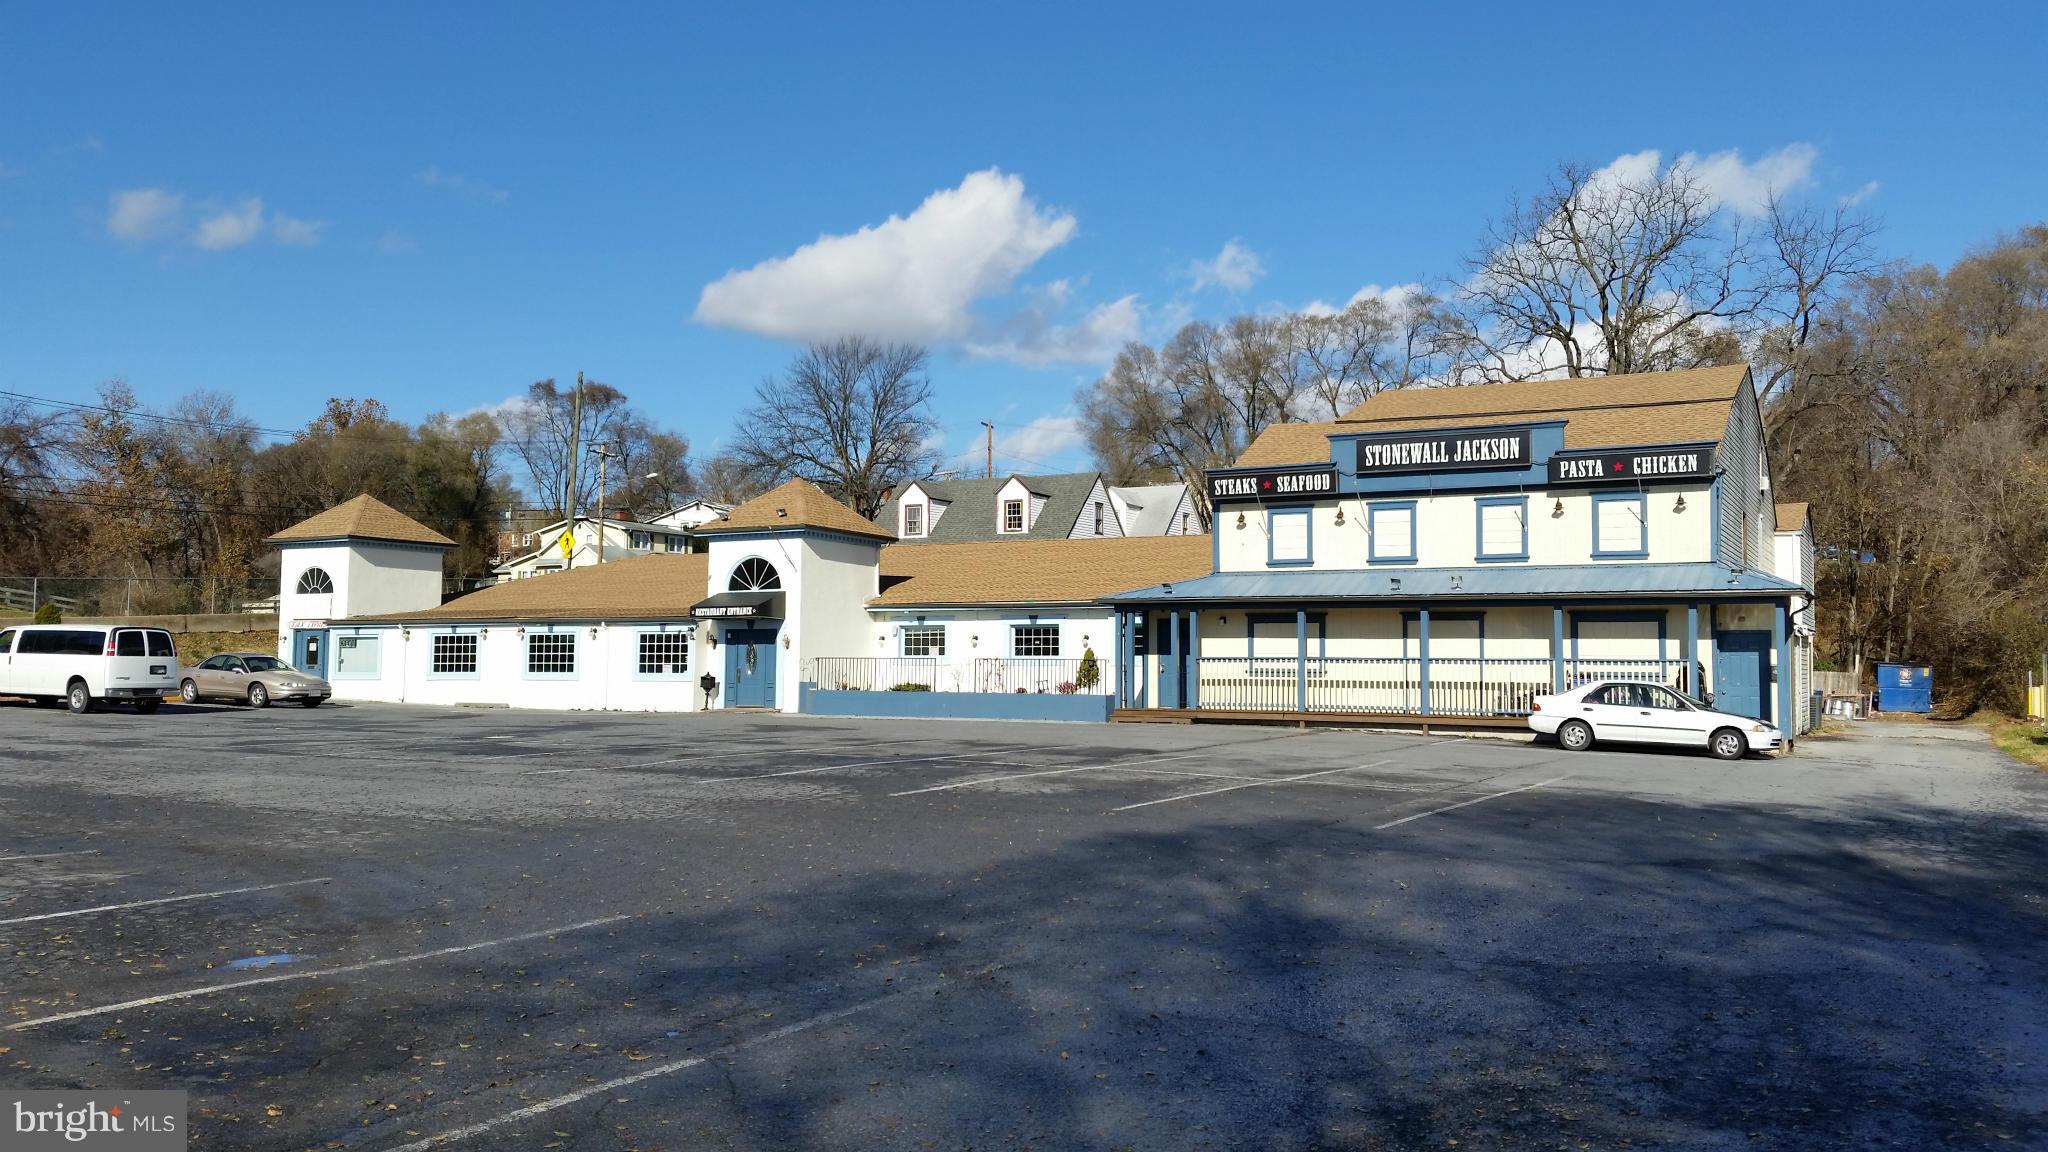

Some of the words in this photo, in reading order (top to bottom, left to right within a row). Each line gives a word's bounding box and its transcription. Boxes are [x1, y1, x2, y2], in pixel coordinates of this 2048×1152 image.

[1365, 441, 1449, 467] STONEWALL
[1453, 437, 1520, 462] JACKSON
[1559, 459, 1604, 479] PASTA
[1633, 454, 1698, 475] CHICKEN
[1214, 477, 1257, 496] STEAKS
[1276, 473, 1330, 493] SEAFOOD
[695, 607, 726, 617] RESTAURANT
[727, 606, 753, 616] ENTRANCE
